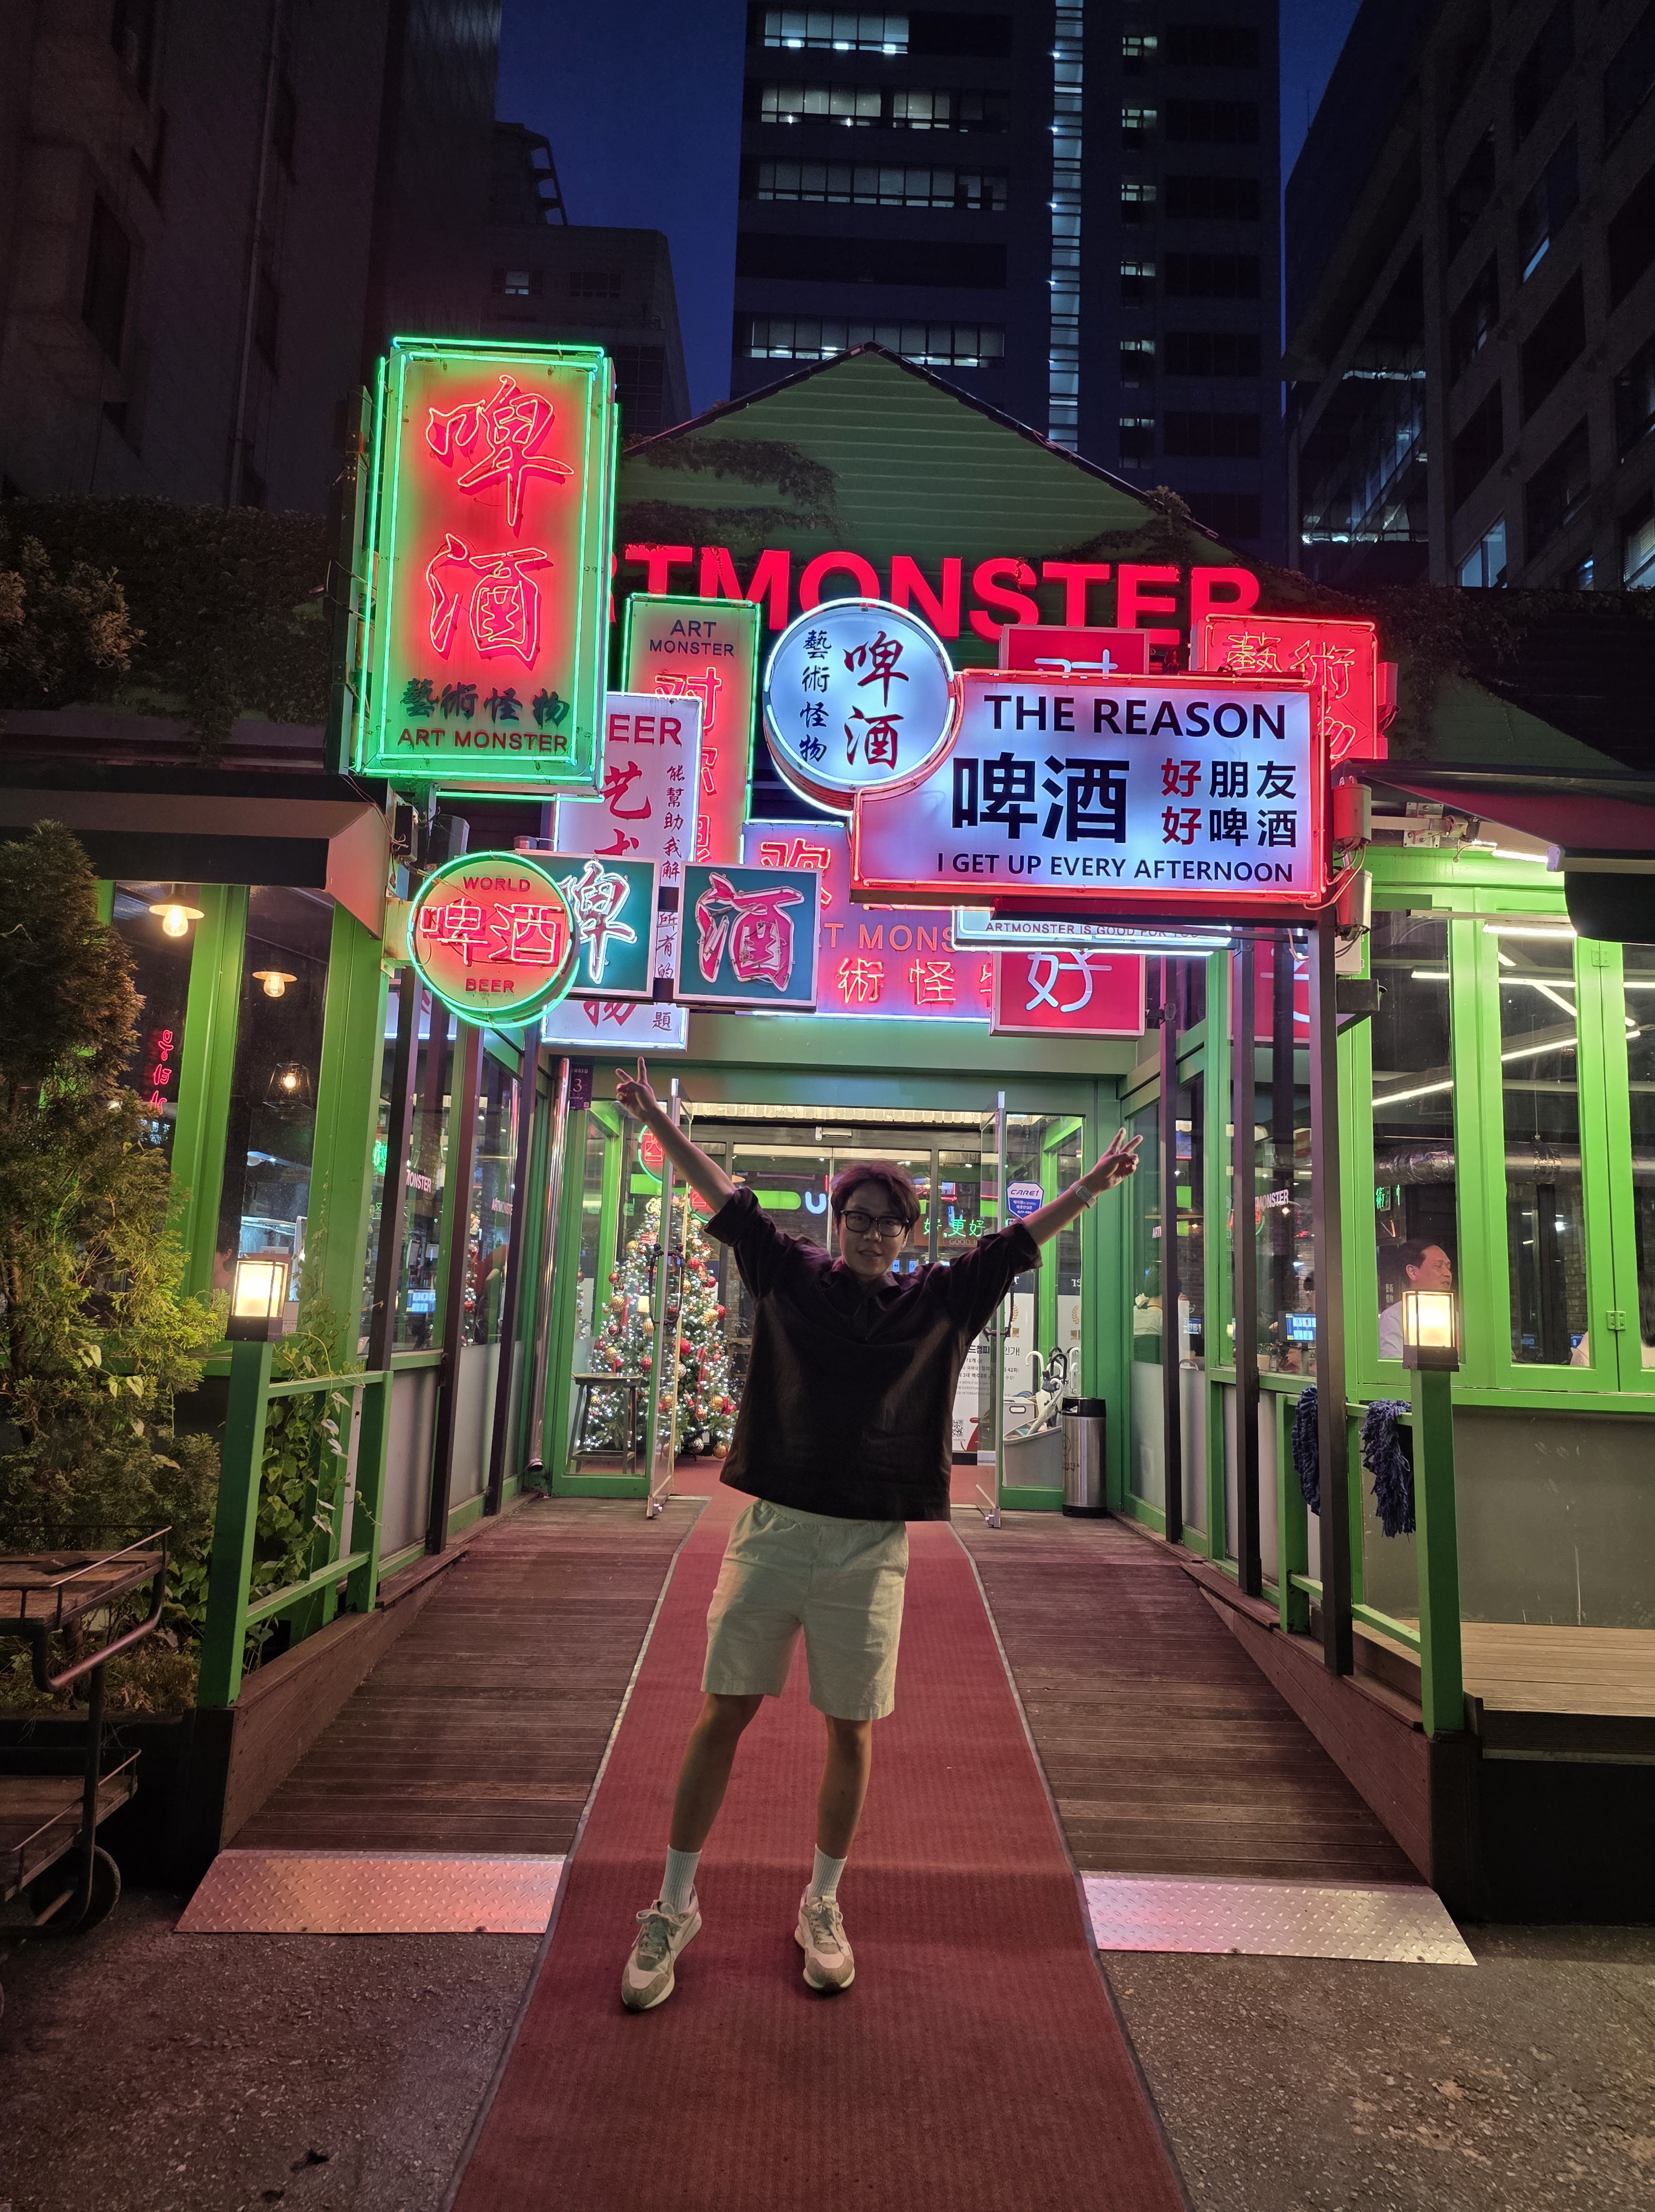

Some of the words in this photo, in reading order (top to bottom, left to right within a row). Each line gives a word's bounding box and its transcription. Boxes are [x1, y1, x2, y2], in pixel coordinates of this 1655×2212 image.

[425, 374, 574, 670] 啤酒
[611, 542, 1264, 648] TMONSTER
[649, 638, 735, 658] MONSTER
[670, 619, 717, 638] ART
[400, 678, 571, 728] 藝術怪物
[799, 629, 832, 763] 藝術怪物
[842, 630, 910, 770] 啤酒
[608, 713, 683, 748] EER
[983, 695, 1075, 733] THE
[1092, 698, 1286, 740] REASON
[397, 728, 446, 748] ART
[454, 731, 568, 754] MONSTER
[951, 752, 1130, 845] 啤酒
[1162, 758, 1297, 800] 好朋友
[1162, 806, 1297, 848] 好啤酒
[463, 876, 531, 893] WORLD
[937, 852, 944, 872] I
[952, 853, 1000, 875] GET
[1007, 854, 1041, 875] UP
[1050, 857, 1126, 878] EVERY
[1133, 860, 1293, 883] AFTERNOON
[419, 898, 565, 968] 啤酒
[859, 924, 957, 952] MONS
[986, 922, 1075, 935] ARTMONSTER
[1080, 925, 1091, 935] IS
[1096, 926, 1134, 936] GOOD
[465, 977, 514, 994] BEER
